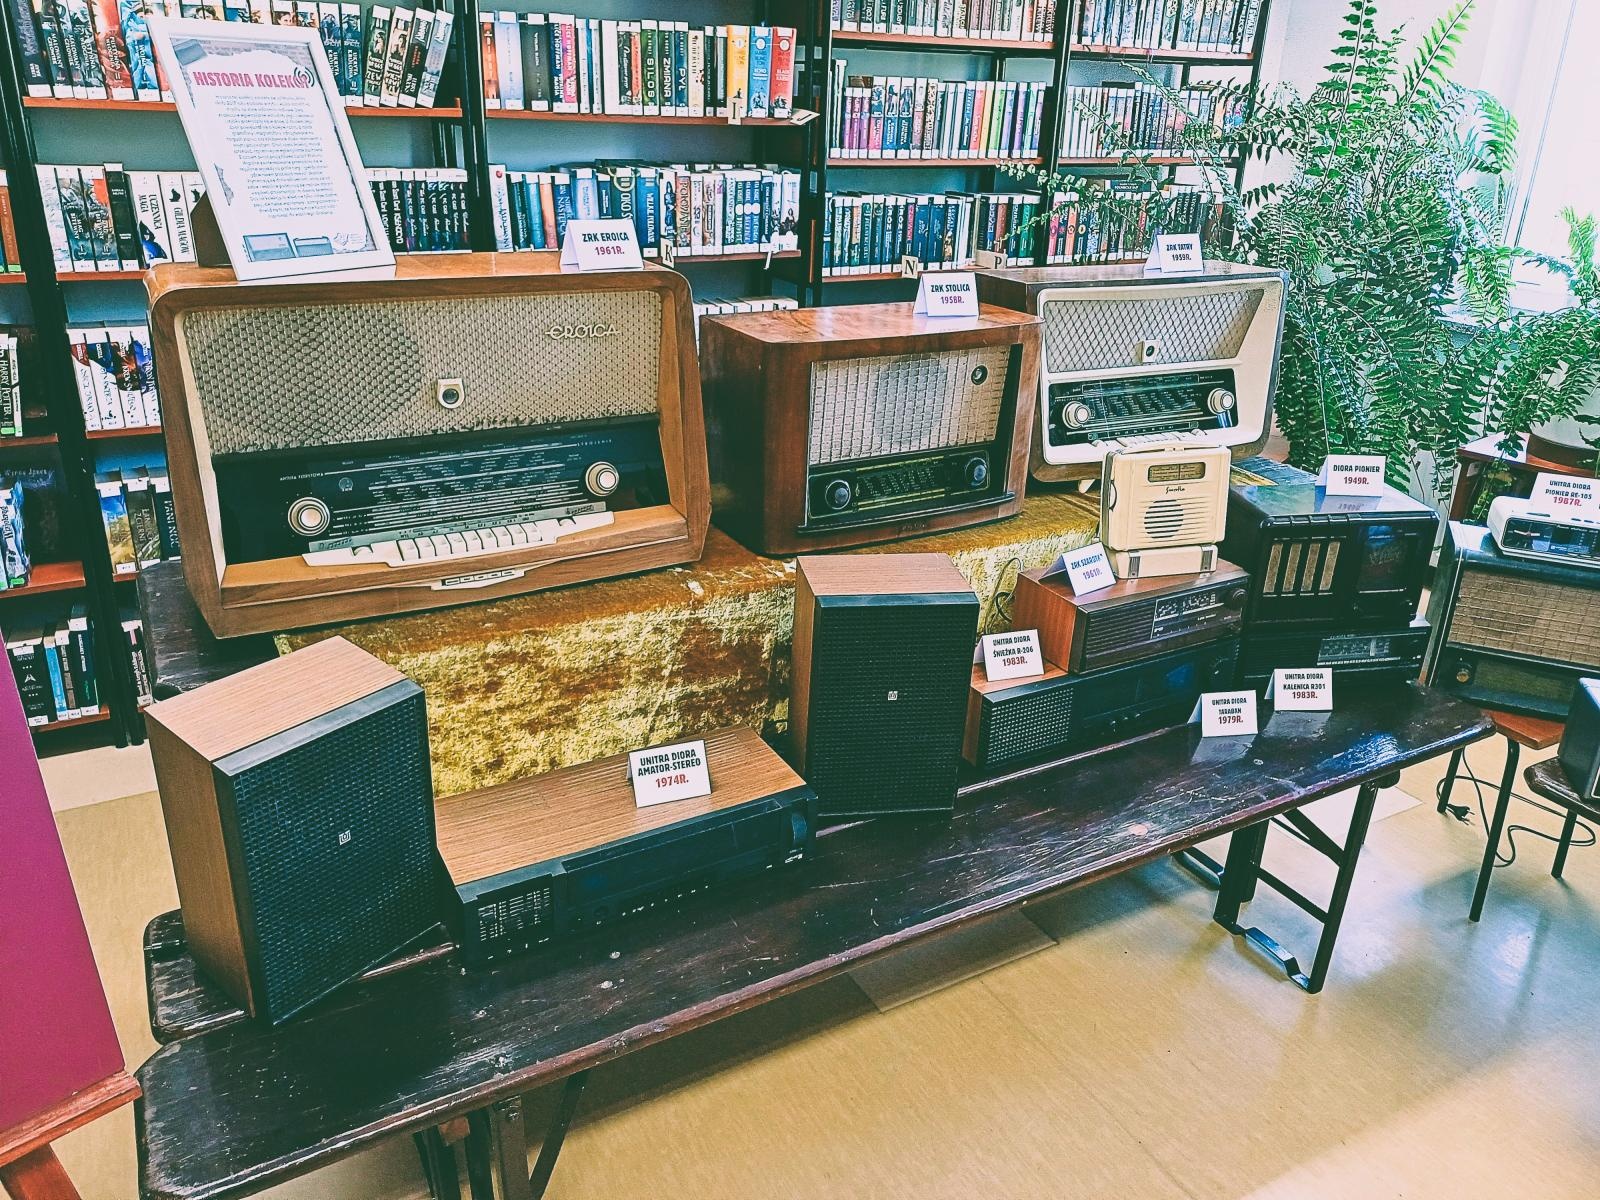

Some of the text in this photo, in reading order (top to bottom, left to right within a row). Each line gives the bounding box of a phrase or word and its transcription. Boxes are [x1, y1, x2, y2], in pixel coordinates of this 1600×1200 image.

[193, 72, 255, 87] HISTORIA
[647, 58, 655, 98] SILOS
[663, 57, 672, 98] ZMIANA
[138, 194, 149, 213] MAGA
[148, 193, 163, 230] UCZENNICA
[582, 232, 629, 242] ZRK EROICA
[595, 246, 625, 255] 1961R.
[664, 244, 673, 263] K
[905, 260, 915, 275] N
[995, 256, 1002, 269] P
[945, 284, 970, 292] STOLICA
[0, 360, 12, 416] HARRY POTTER
[1550, 480, 1571, 488] UNITRA
[1553, 496, 1582, 506] 1987R.
[993, 638, 1013, 646] UNITRA
[993, 646, 1033, 657] ŚNIEŻKA R-206
[1002, 656, 1027, 666] 1983R.
[1218, 716, 1244, 724] 1979R.
[640, 749, 696, 766] UNITRA DIORA
[638, 758, 701, 776] AMATOR-STEREO
[656, 774, 689, 788] 1974R.
